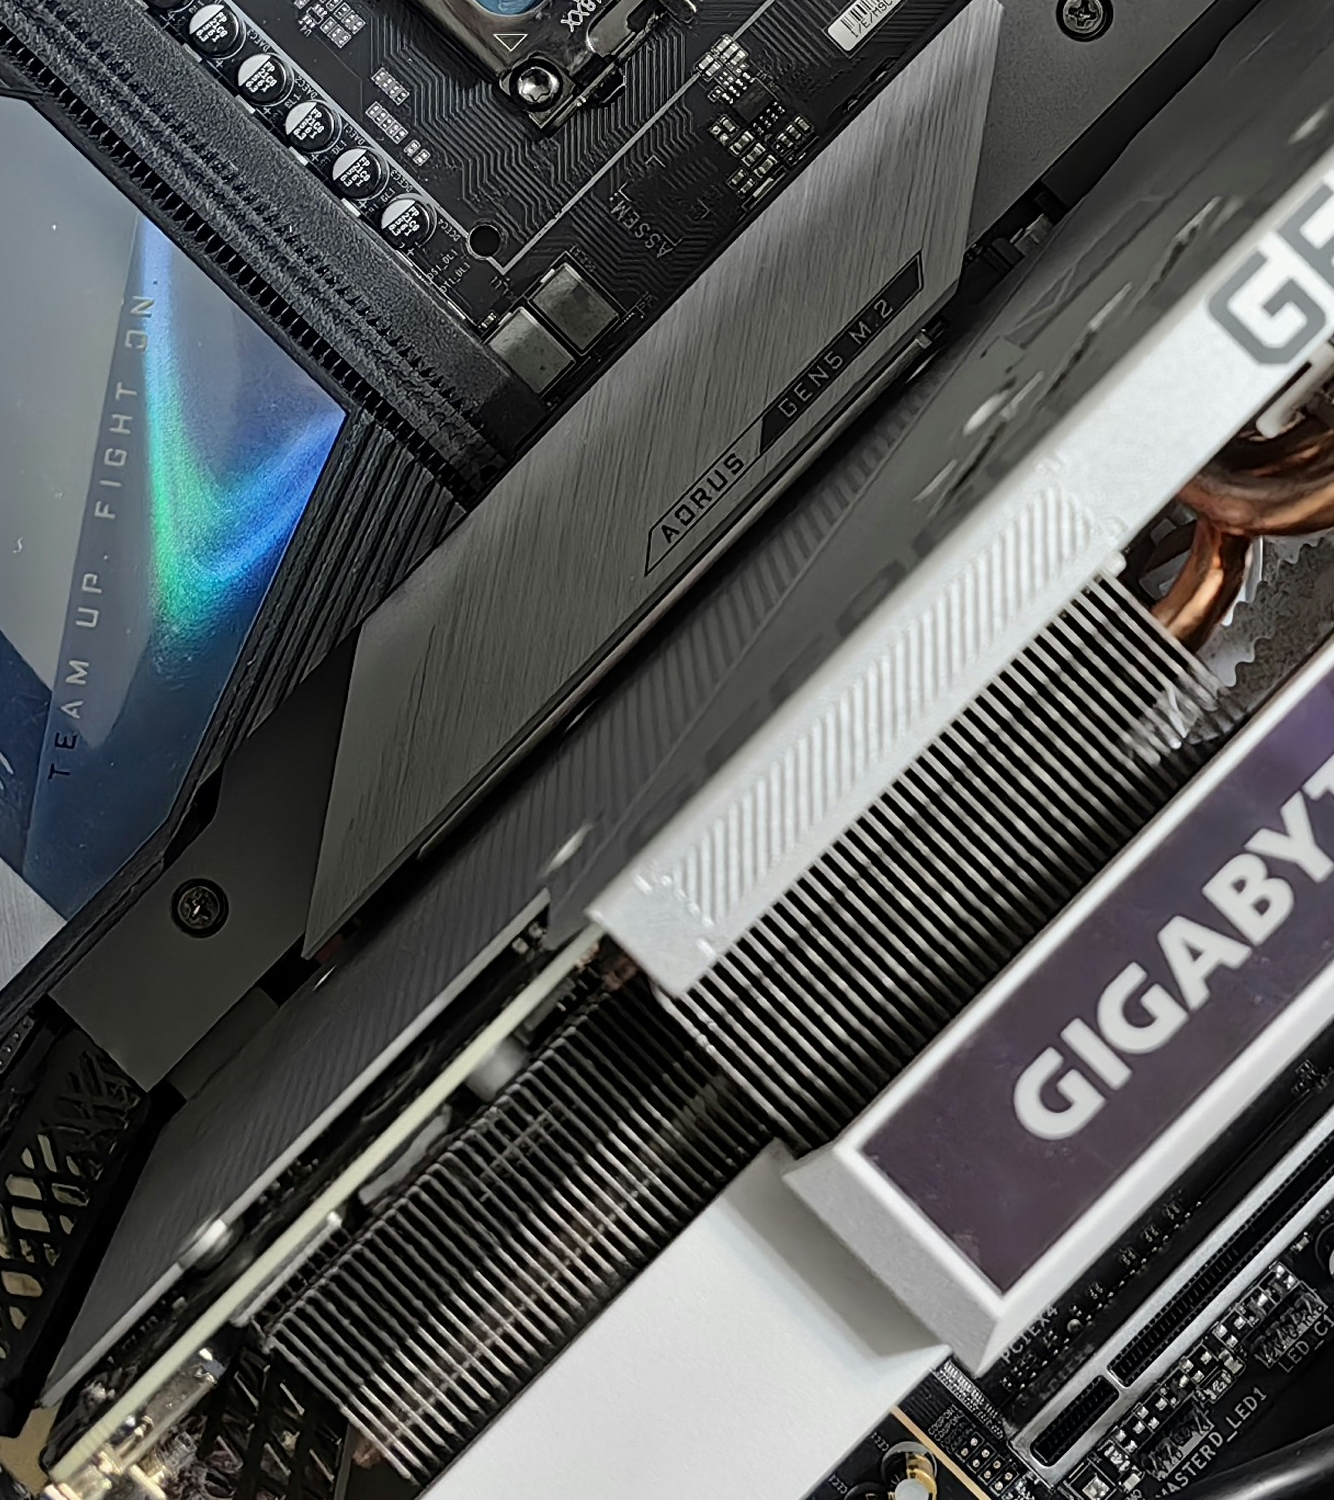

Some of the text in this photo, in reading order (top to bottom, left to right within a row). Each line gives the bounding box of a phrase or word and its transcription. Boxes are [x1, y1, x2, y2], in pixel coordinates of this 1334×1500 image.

[215, 12, 227, 24] FP
[310, 108, 322, 120] FP
[358, 156, 370, 169] FP
[408, 206, 420, 219] FP
[656, 296, 894, 544] AORUS GEN5 M.2
[48, 657, 89, 780] TEAM
[95, 381, 139, 520] FIGHT
[123, 295, 155, 351] ON
